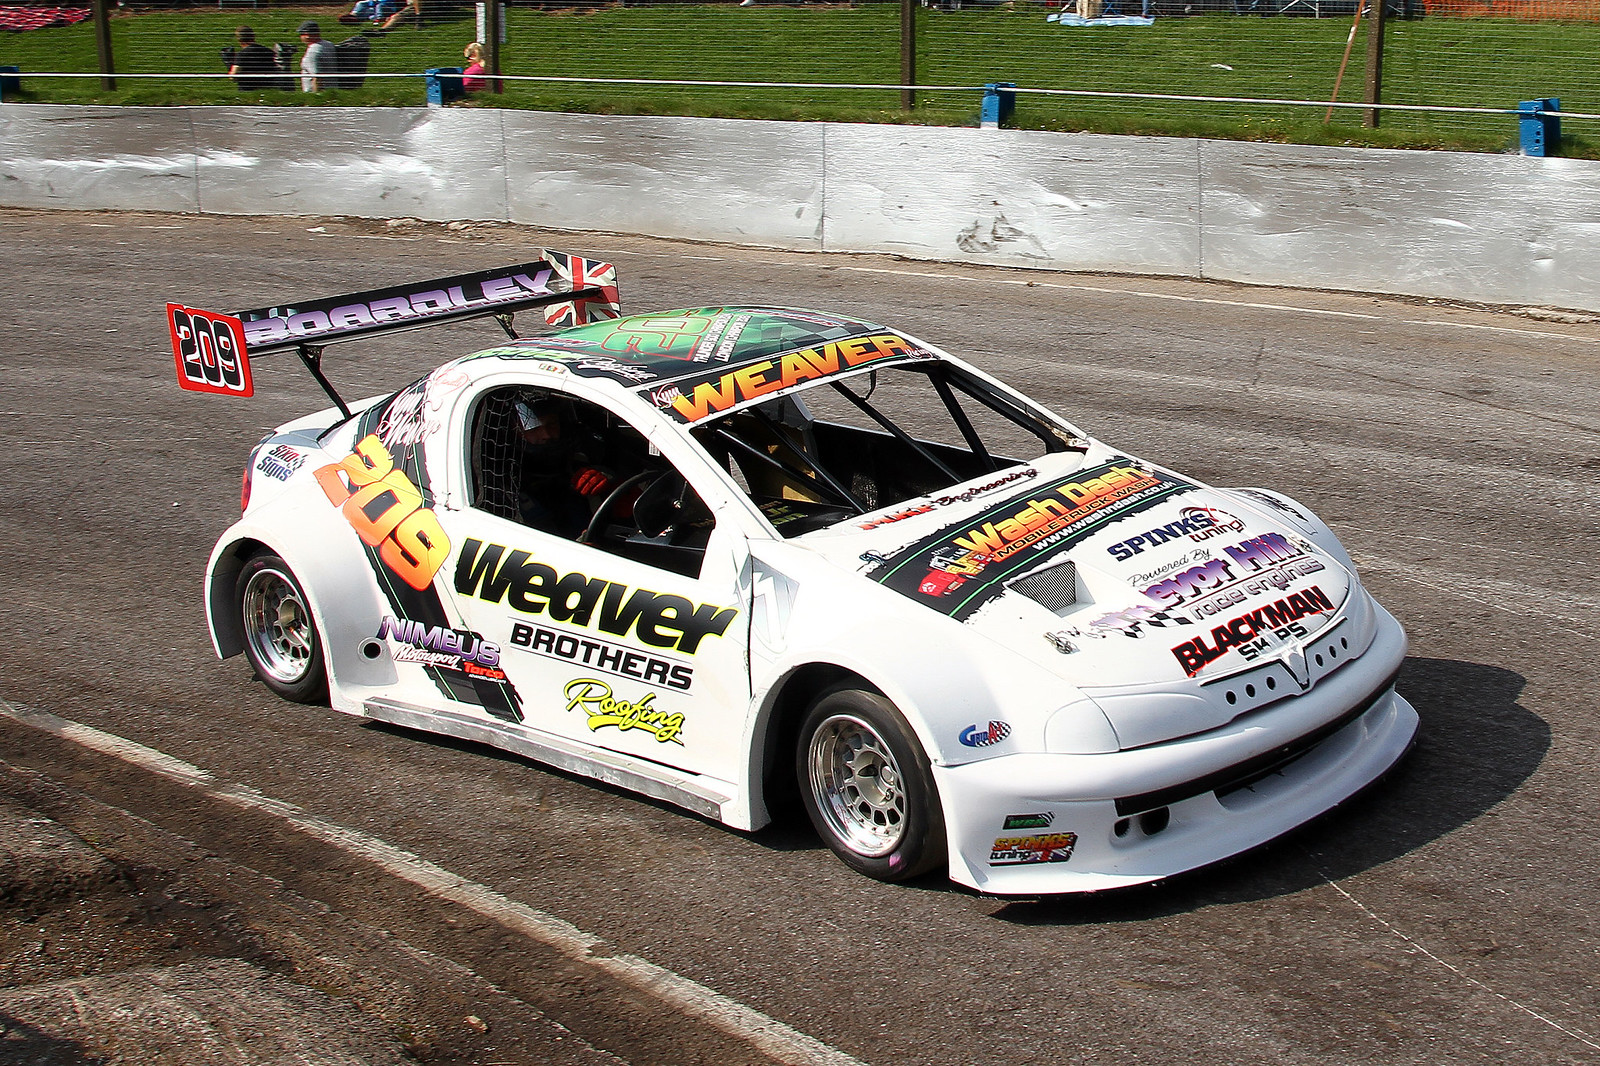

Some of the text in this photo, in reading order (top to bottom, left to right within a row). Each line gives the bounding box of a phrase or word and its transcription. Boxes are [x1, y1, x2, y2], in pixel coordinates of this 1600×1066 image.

[243, 269, 554, 345] BOARDLEY
[173, 308, 246, 391] 209
[670, 334, 912, 422] WEAVER
[312, 433, 451, 592] 209
[952, 466, 1146, 554] Wash Dash
[996, 479, 1156, 558] MOBILE TRUCK WASH
[1032, 480, 1177, 550] www.washndash.co.uk
[1106, 514, 1214, 562] SPINKS
[1189, 519, 1245, 544] tuning
[1127, 554, 1190, 587] Powered
[1222, 532, 1306, 572] Hill
[453, 537, 740, 655] Weaver
[1189, 557, 1326, 621] race engines
[376, 615, 500, 666] NIMBUS
[510, 623, 693, 690] BROTHERS
[1171, 585, 1336, 678] BLACKMAN
[564, 677, 685, 743] Roofing
[989, 851, 1032, 862] tuning
[991, 833, 1073, 851] SPINKS
